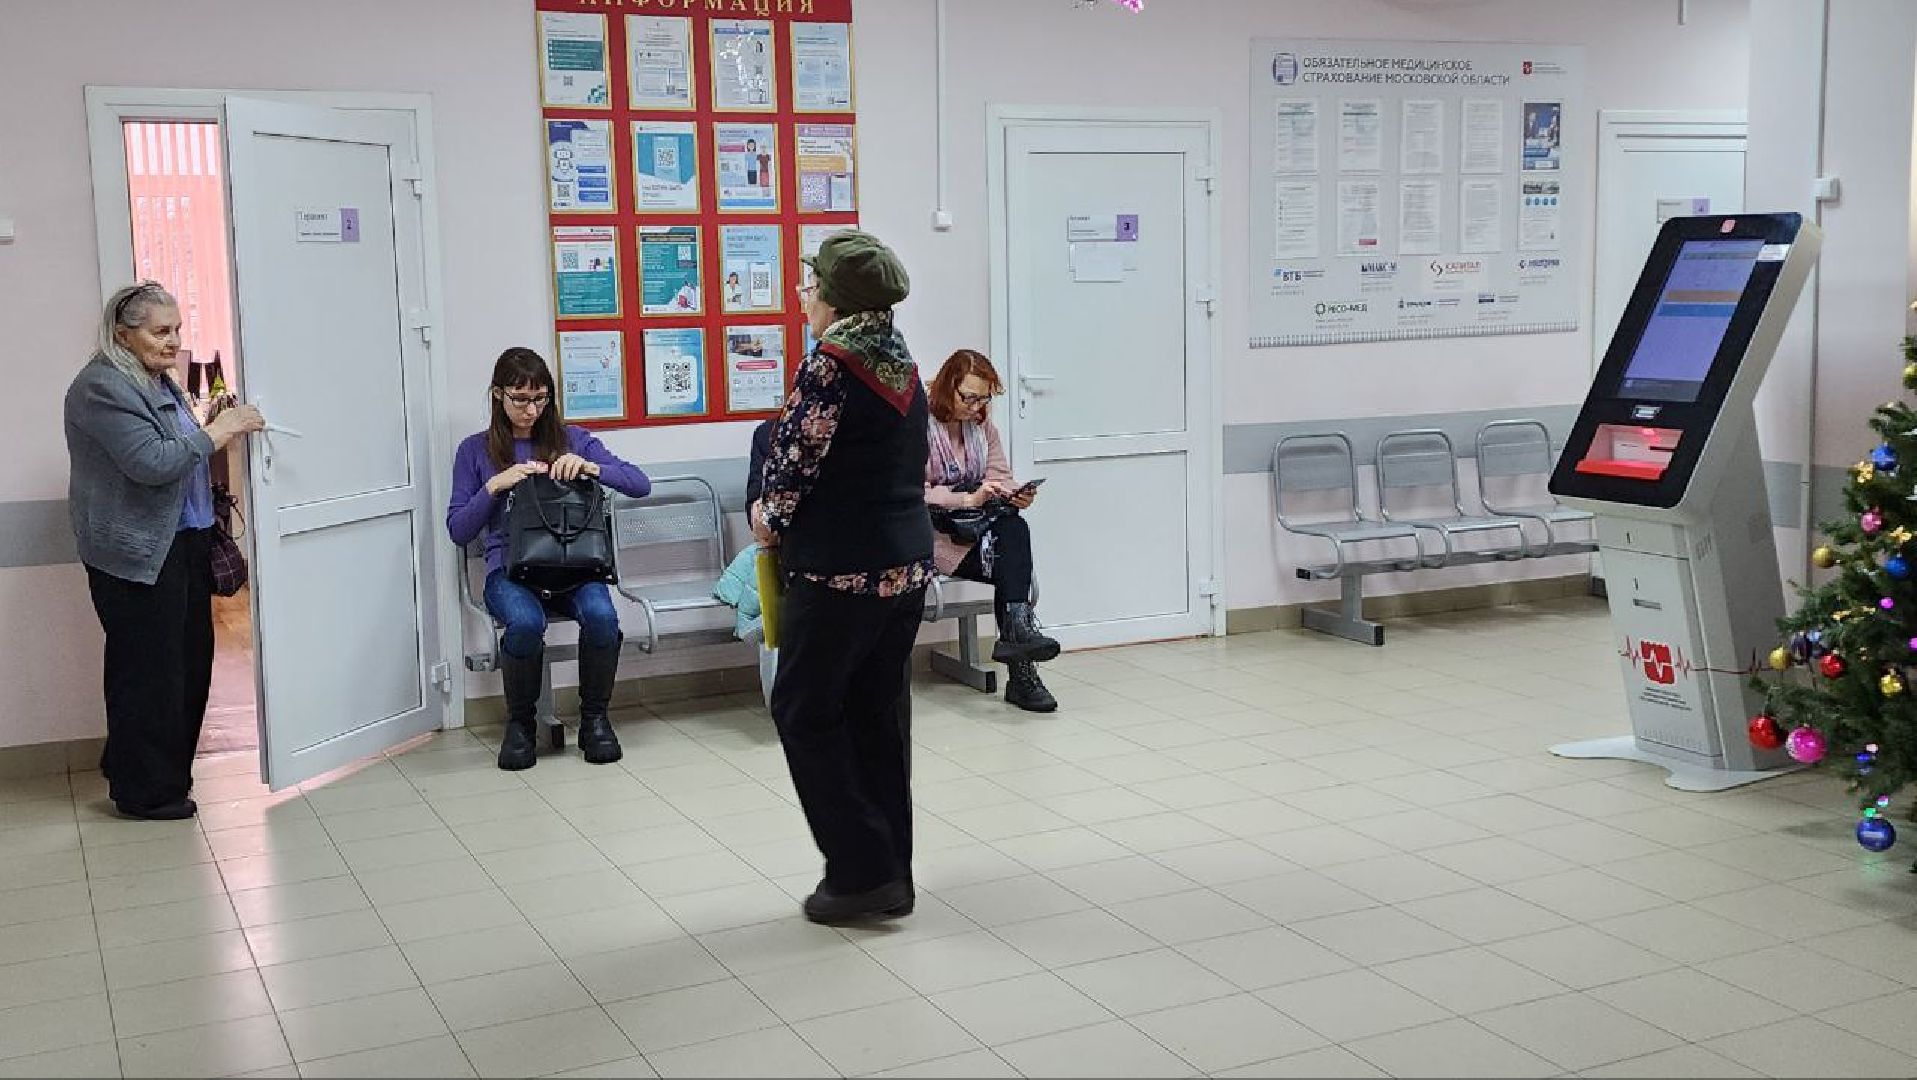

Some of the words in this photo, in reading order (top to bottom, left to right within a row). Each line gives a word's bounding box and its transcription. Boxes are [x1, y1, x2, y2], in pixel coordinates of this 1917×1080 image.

[578, 0, 815, 16] РМАЦИЯ
[1303, 57, 1390, 69] ОБЯЗАТЕЛЬНОЕ
[1391, 58, 1473, 70] МЕДИЦИНСКОЕ
[1303, 72, 1383, 83] СТРАХОВАНИЕ
[1385, 72, 1459, 84] МОСКОВСКОЙ
[1460, 74, 1510, 85] ОБЛАСТИ
